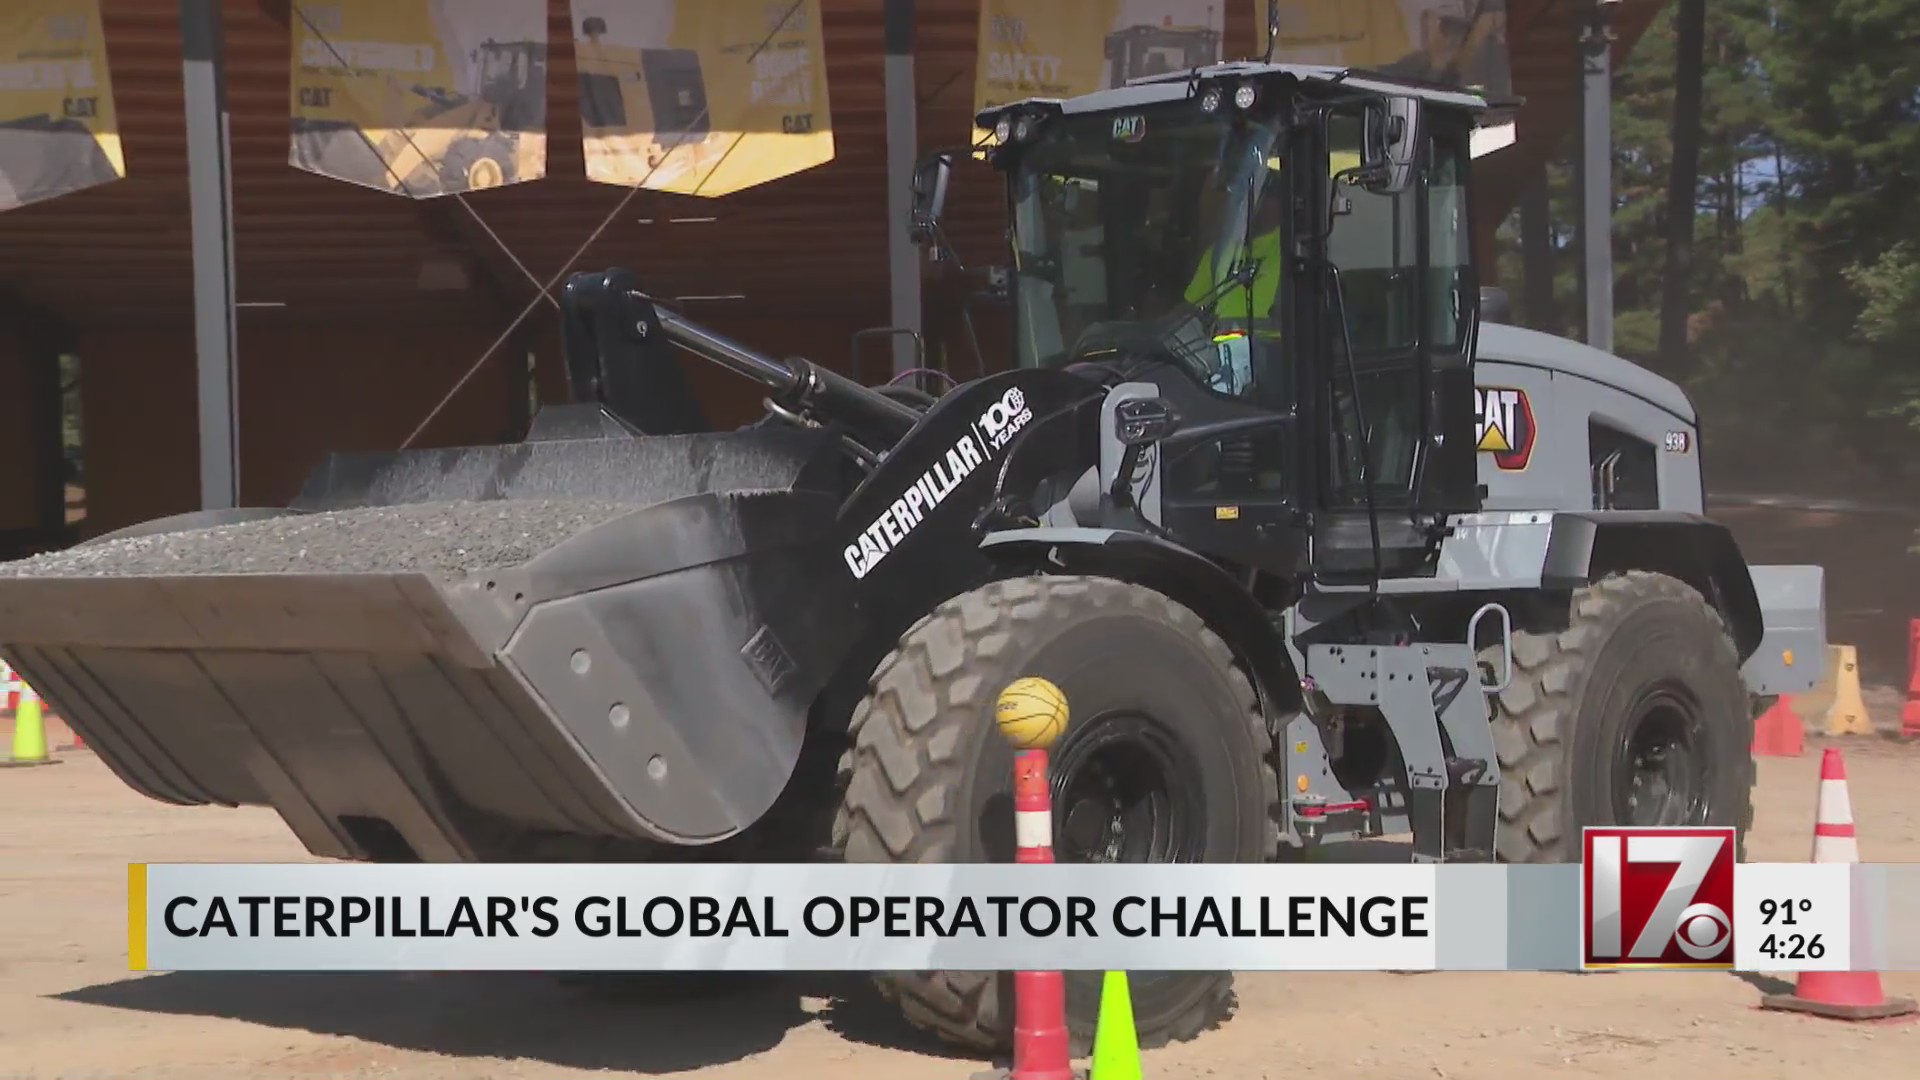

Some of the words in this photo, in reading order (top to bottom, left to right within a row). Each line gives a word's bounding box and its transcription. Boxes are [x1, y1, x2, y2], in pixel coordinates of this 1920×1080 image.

[988, 52, 1063, 81] SAFETY
[63, 97, 99, 117] CAT
[299, 86, 331, 107] CAT
[782, 113, 813, 133] CAT
[1113, 115, 1139, 137] CAT
[979, 386, 1025, 438] 100
[989, 407, 1033, 450] YEARS
[1665, 432, 1685, 451] 938
[843, 434, 982, 580] CATERPILLAR
